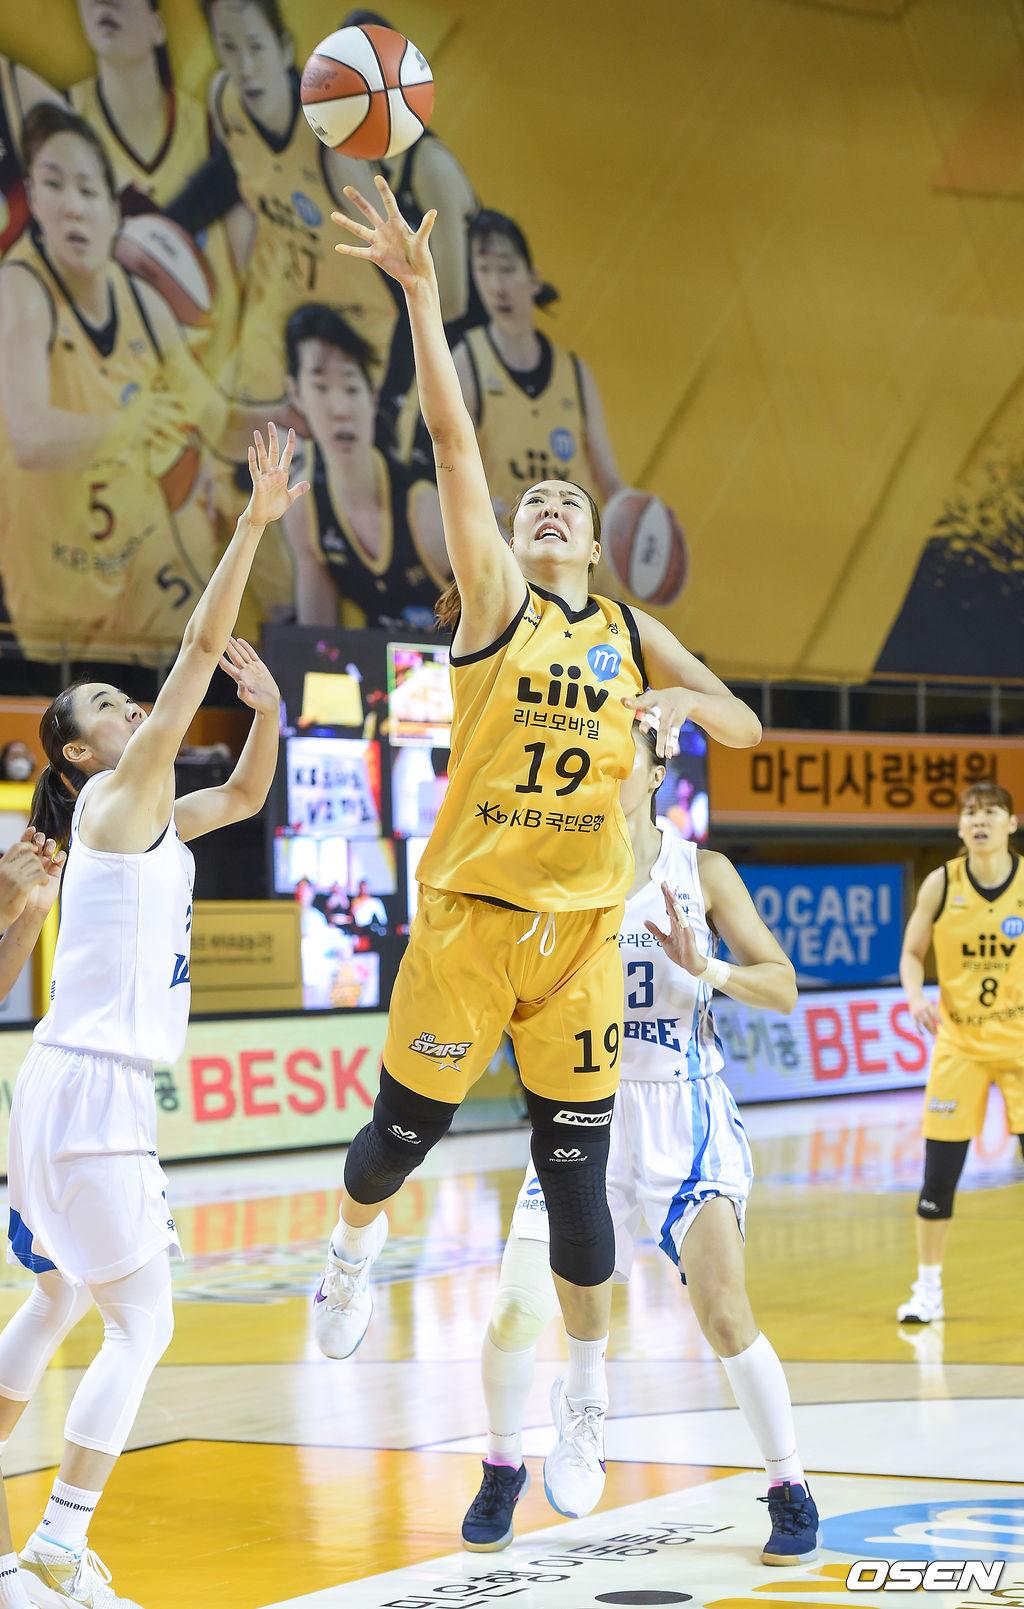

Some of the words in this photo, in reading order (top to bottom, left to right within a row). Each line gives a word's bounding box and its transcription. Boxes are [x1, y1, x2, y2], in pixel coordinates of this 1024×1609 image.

[90, 482, 115, 541] 5
[156, 564, 191, 610] 5
[517, 663, 610, 713] Liiv
[513, 708, 600, 740] 리브모바일
[515, 741, 591, 797] 19
[754, 884, 891, 927] OCARI
[961, 934, 1016, 957] Liiv
[979, 977, 998, 1008] 8
[408, 1039, 473, 1059] STARS
[420, 1032, 436, 1043] KB
[573, 1022, 619, 1074] 19
[623, 1018, 681, 1053] BEE
[805, 1001, 928, 1082] BES
[190, 1046, 382, 1124] BESK
